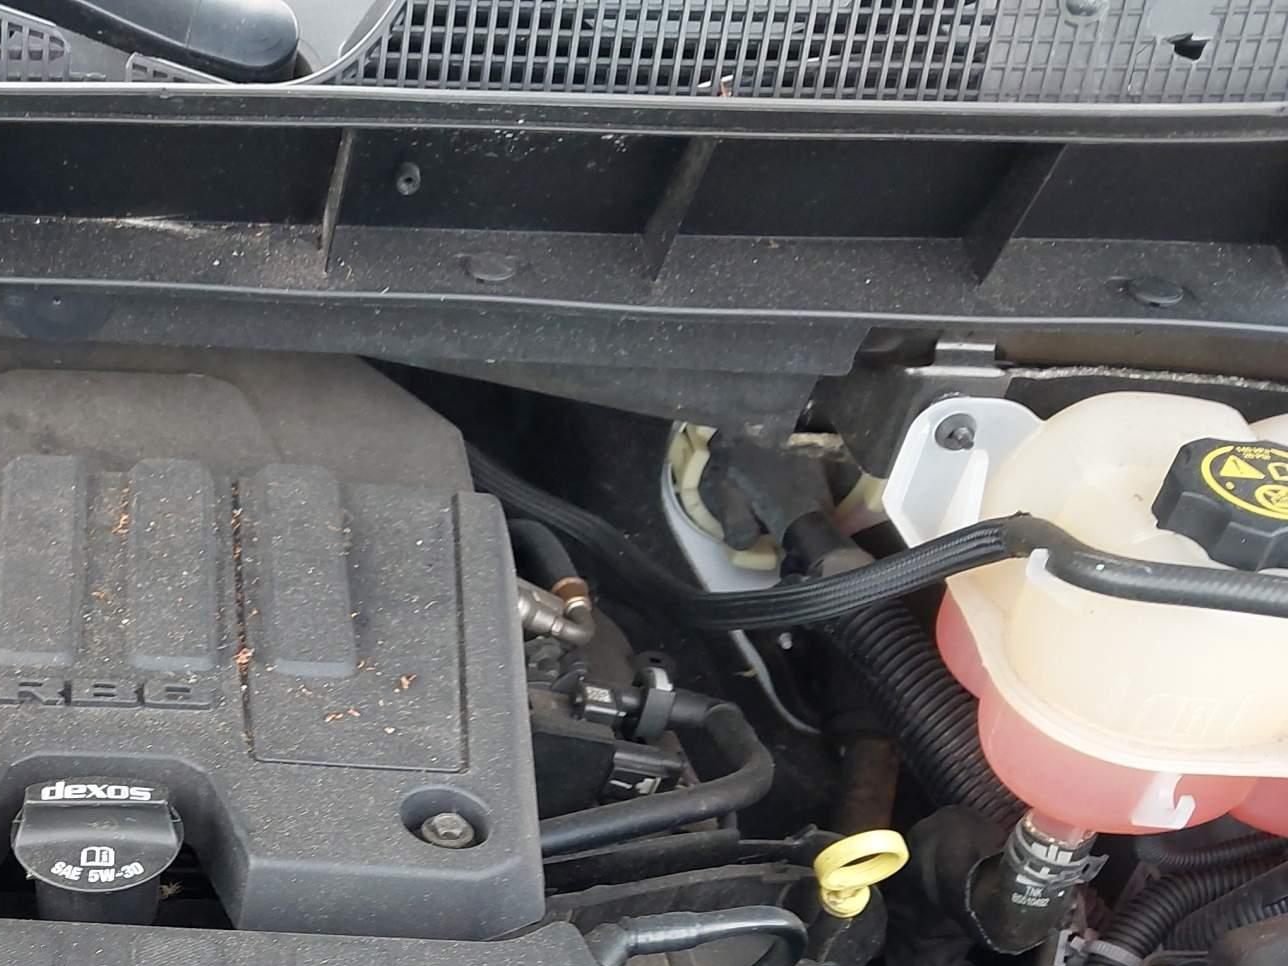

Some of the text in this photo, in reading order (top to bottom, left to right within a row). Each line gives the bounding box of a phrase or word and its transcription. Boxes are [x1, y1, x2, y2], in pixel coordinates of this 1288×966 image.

[40, 781, 156, 801] dexos
[51, 861, 145, 883] SAE 5W-30
